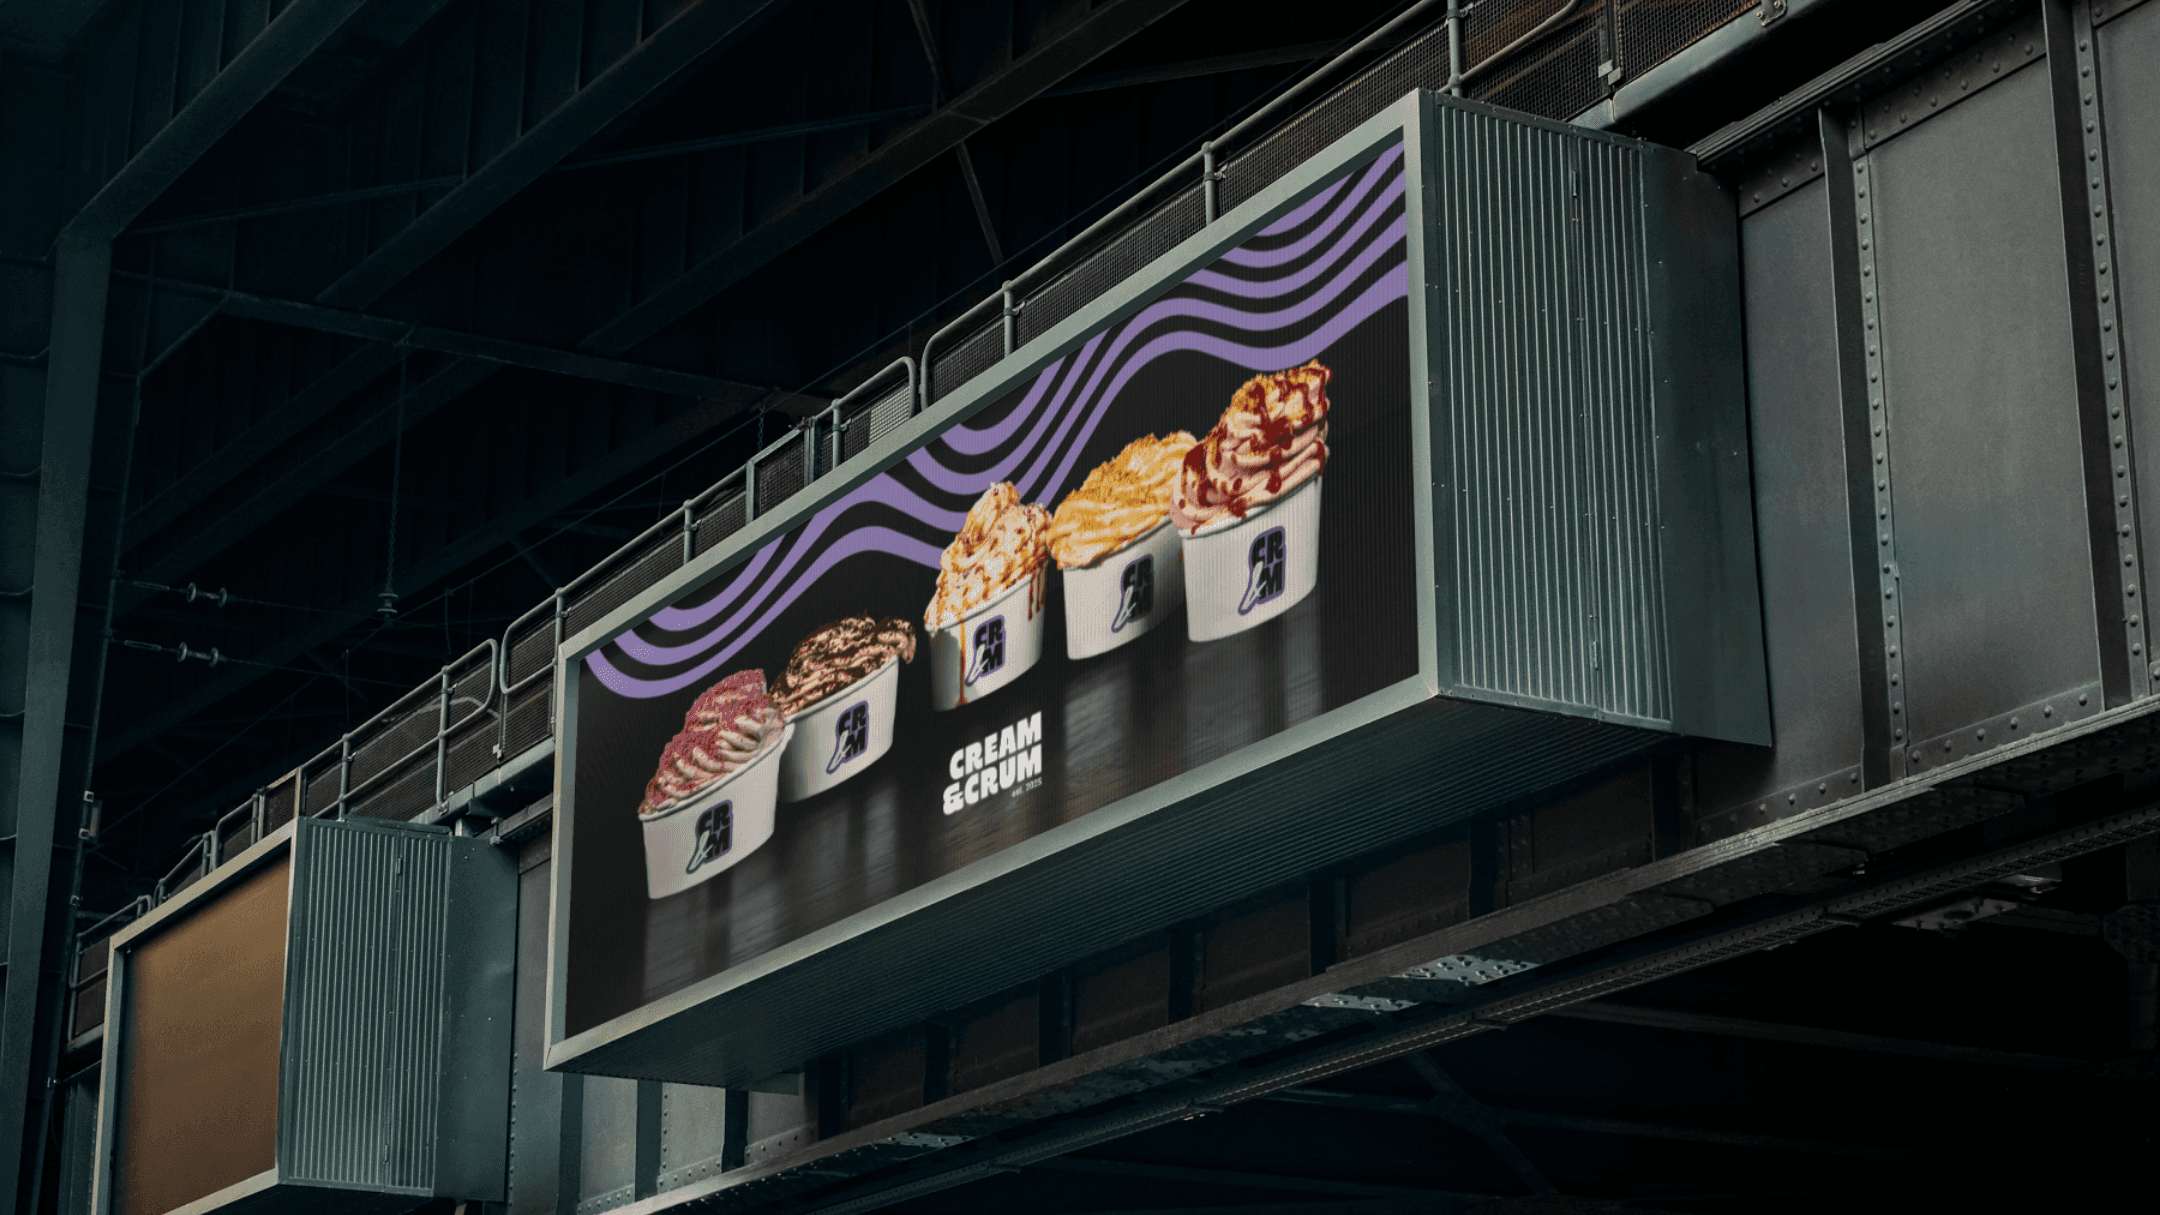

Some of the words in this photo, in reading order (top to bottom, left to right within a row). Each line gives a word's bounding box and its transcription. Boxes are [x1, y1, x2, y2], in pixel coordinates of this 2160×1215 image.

[1251, 530, 1283, 568] CR
[975, 619, 1003, 649] CR
[838, 704, 867, 736] CR
[949, 710, 1042, 780] CREAM
[942, 743, 1042, 815] &CRUM
[698, 804, 731, 836] CR
